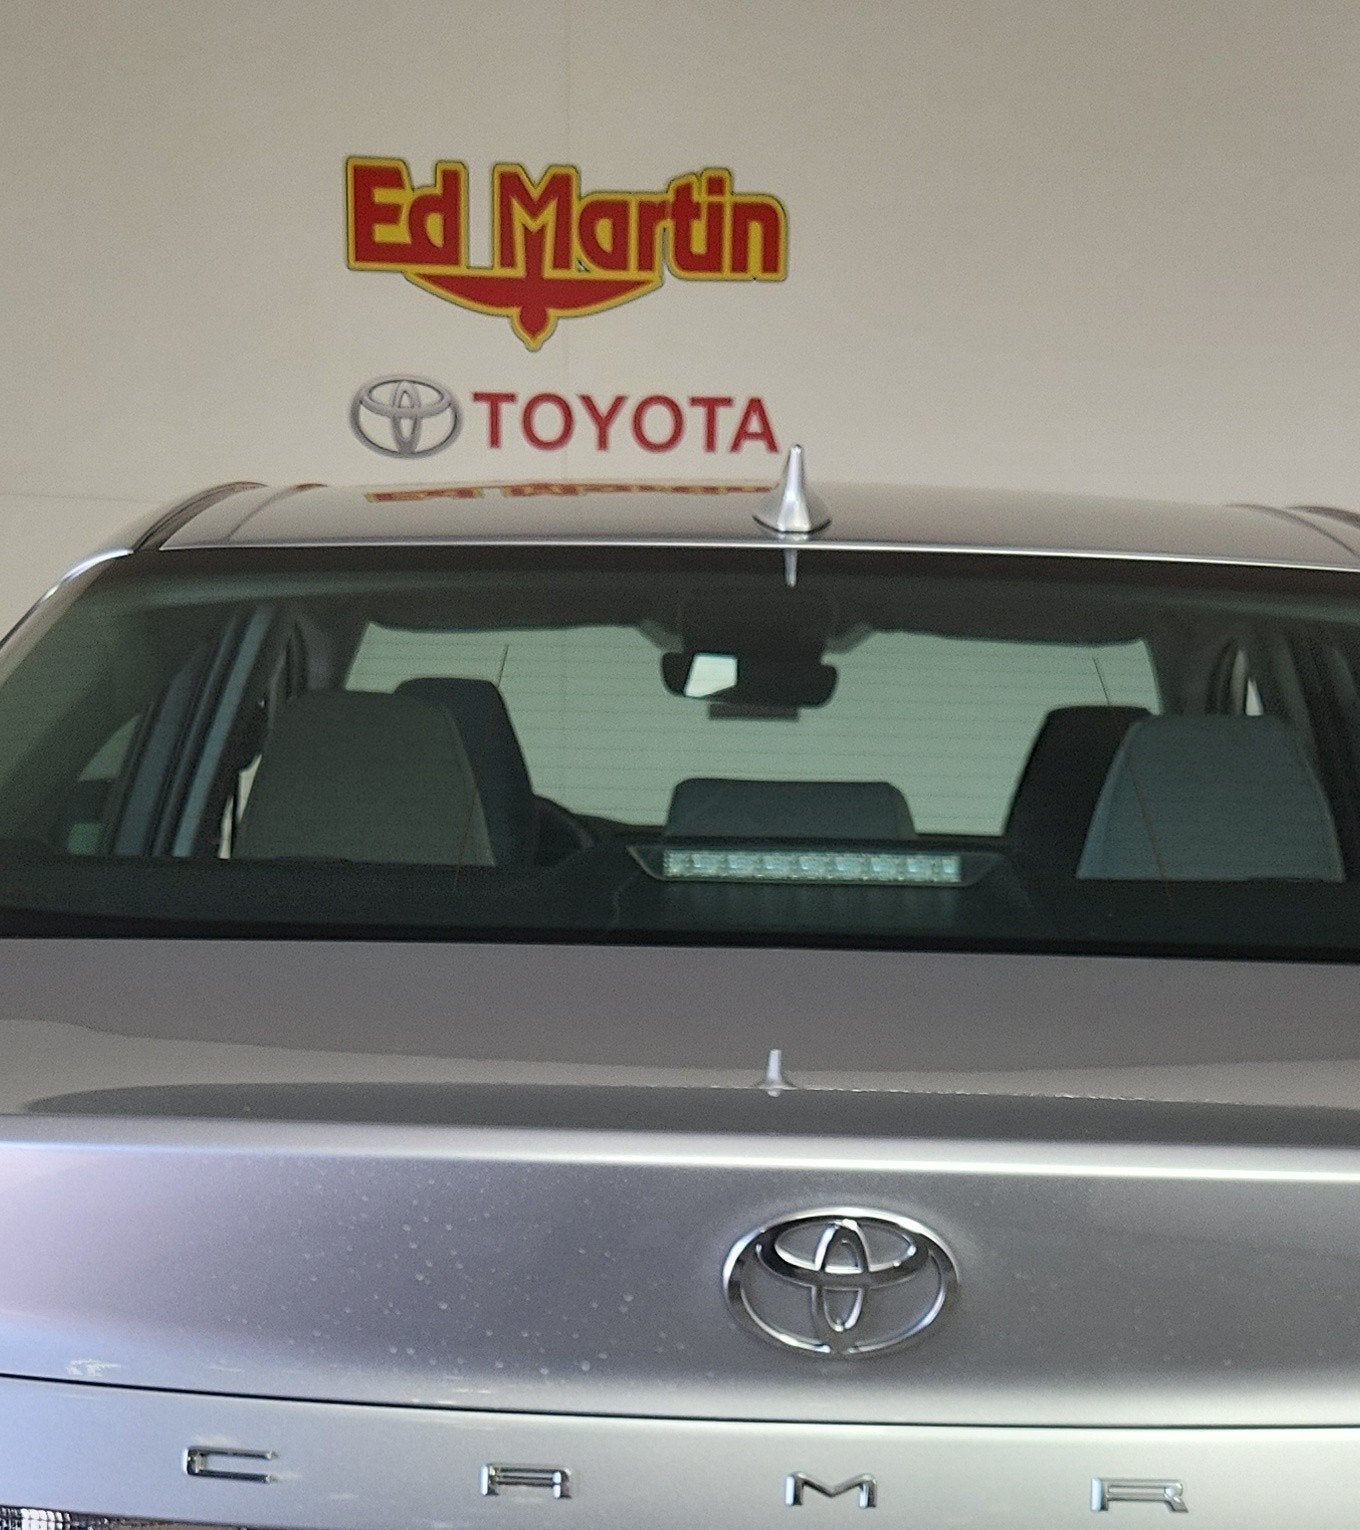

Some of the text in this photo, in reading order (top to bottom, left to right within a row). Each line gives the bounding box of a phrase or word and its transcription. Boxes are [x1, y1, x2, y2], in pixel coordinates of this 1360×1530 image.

[348, 160, 788, 281] Ed Martin
[472, 392, 778, 454] TOYOTA
